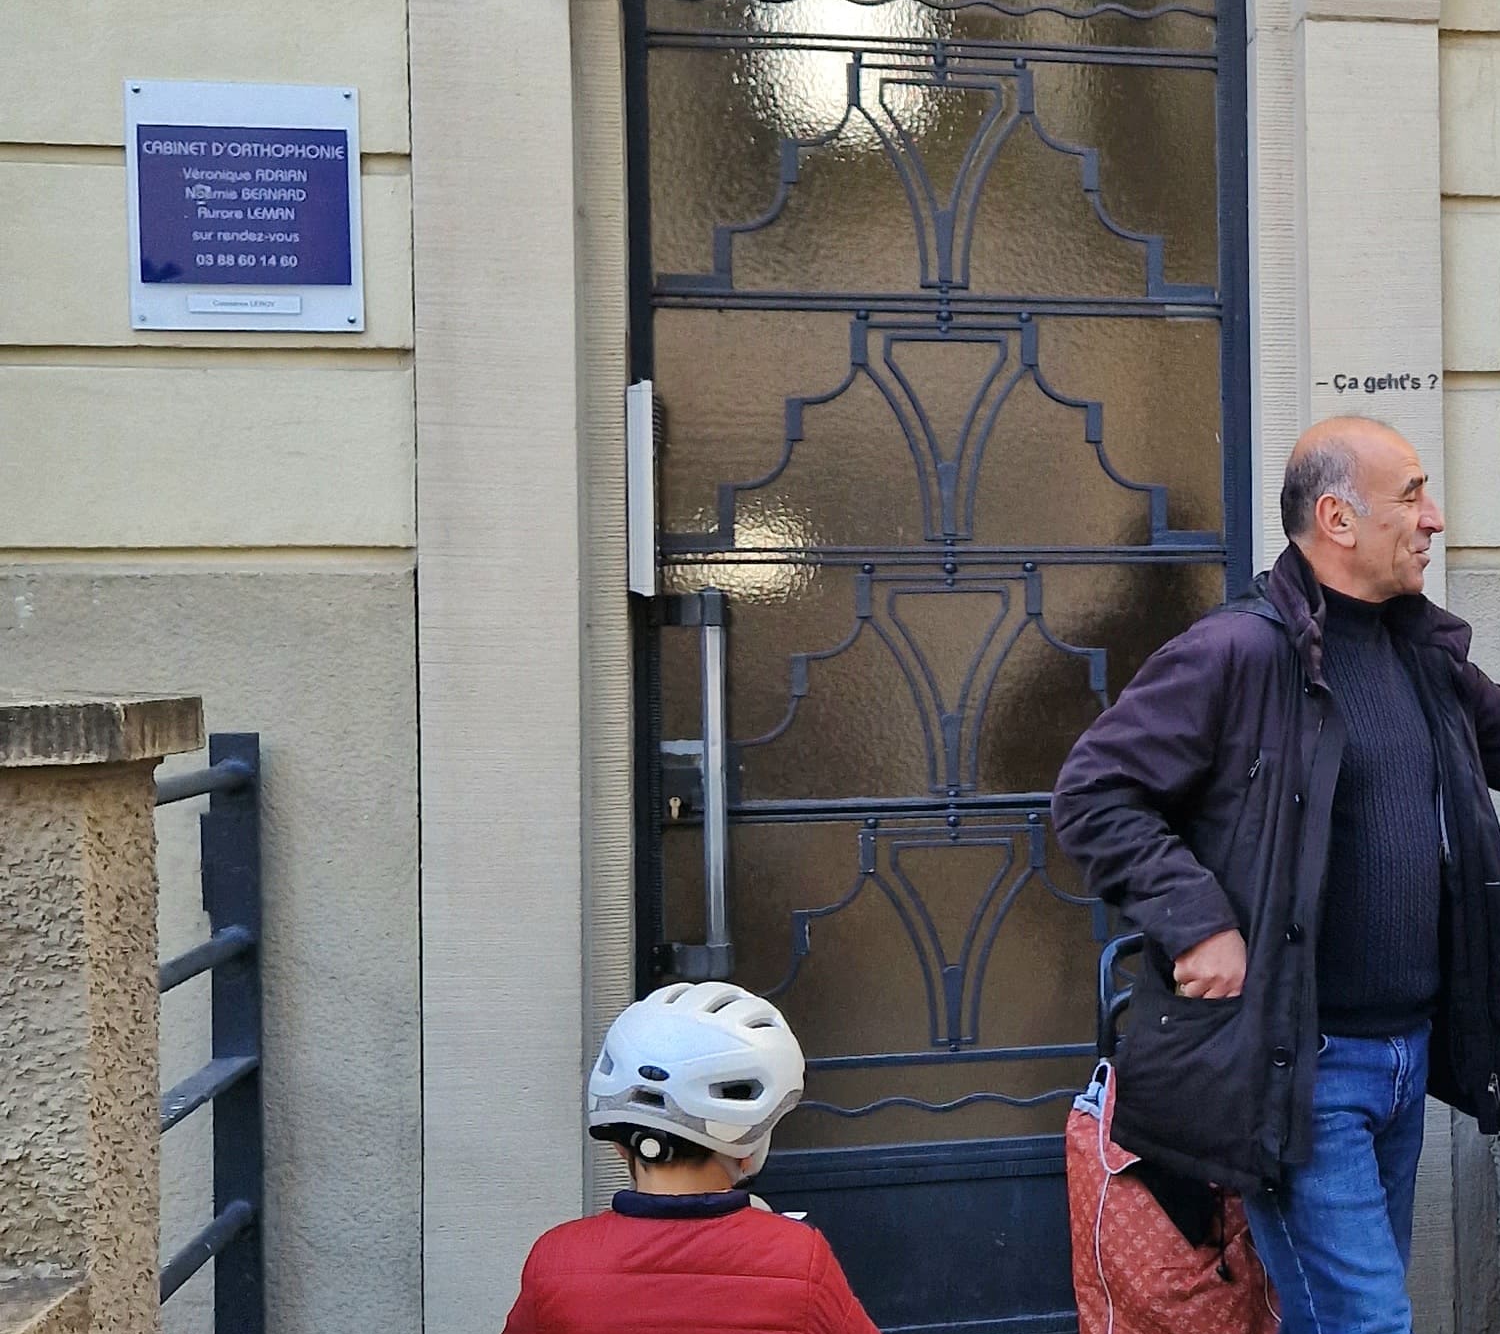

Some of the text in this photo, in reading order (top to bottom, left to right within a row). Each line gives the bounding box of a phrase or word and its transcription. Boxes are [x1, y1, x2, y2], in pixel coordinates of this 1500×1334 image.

[143, 140, 345, 160] CABINET D'ORTHOPHONIE
[182, 167, 308, 183] Véronique ADRIAN
[241, 188, 307, 202] BERNARD
[197, 206, 295, 220] Aurore LEMAN
[192, 229, 300, 243] sur rendez-vous
[196, 254, 298, 267] 03 88 60 14 60
[1333, 374, 1359, 393] Ça
[1363, 373, 1421, 394] geht's
[1427, 374, 1439, 390] ?
